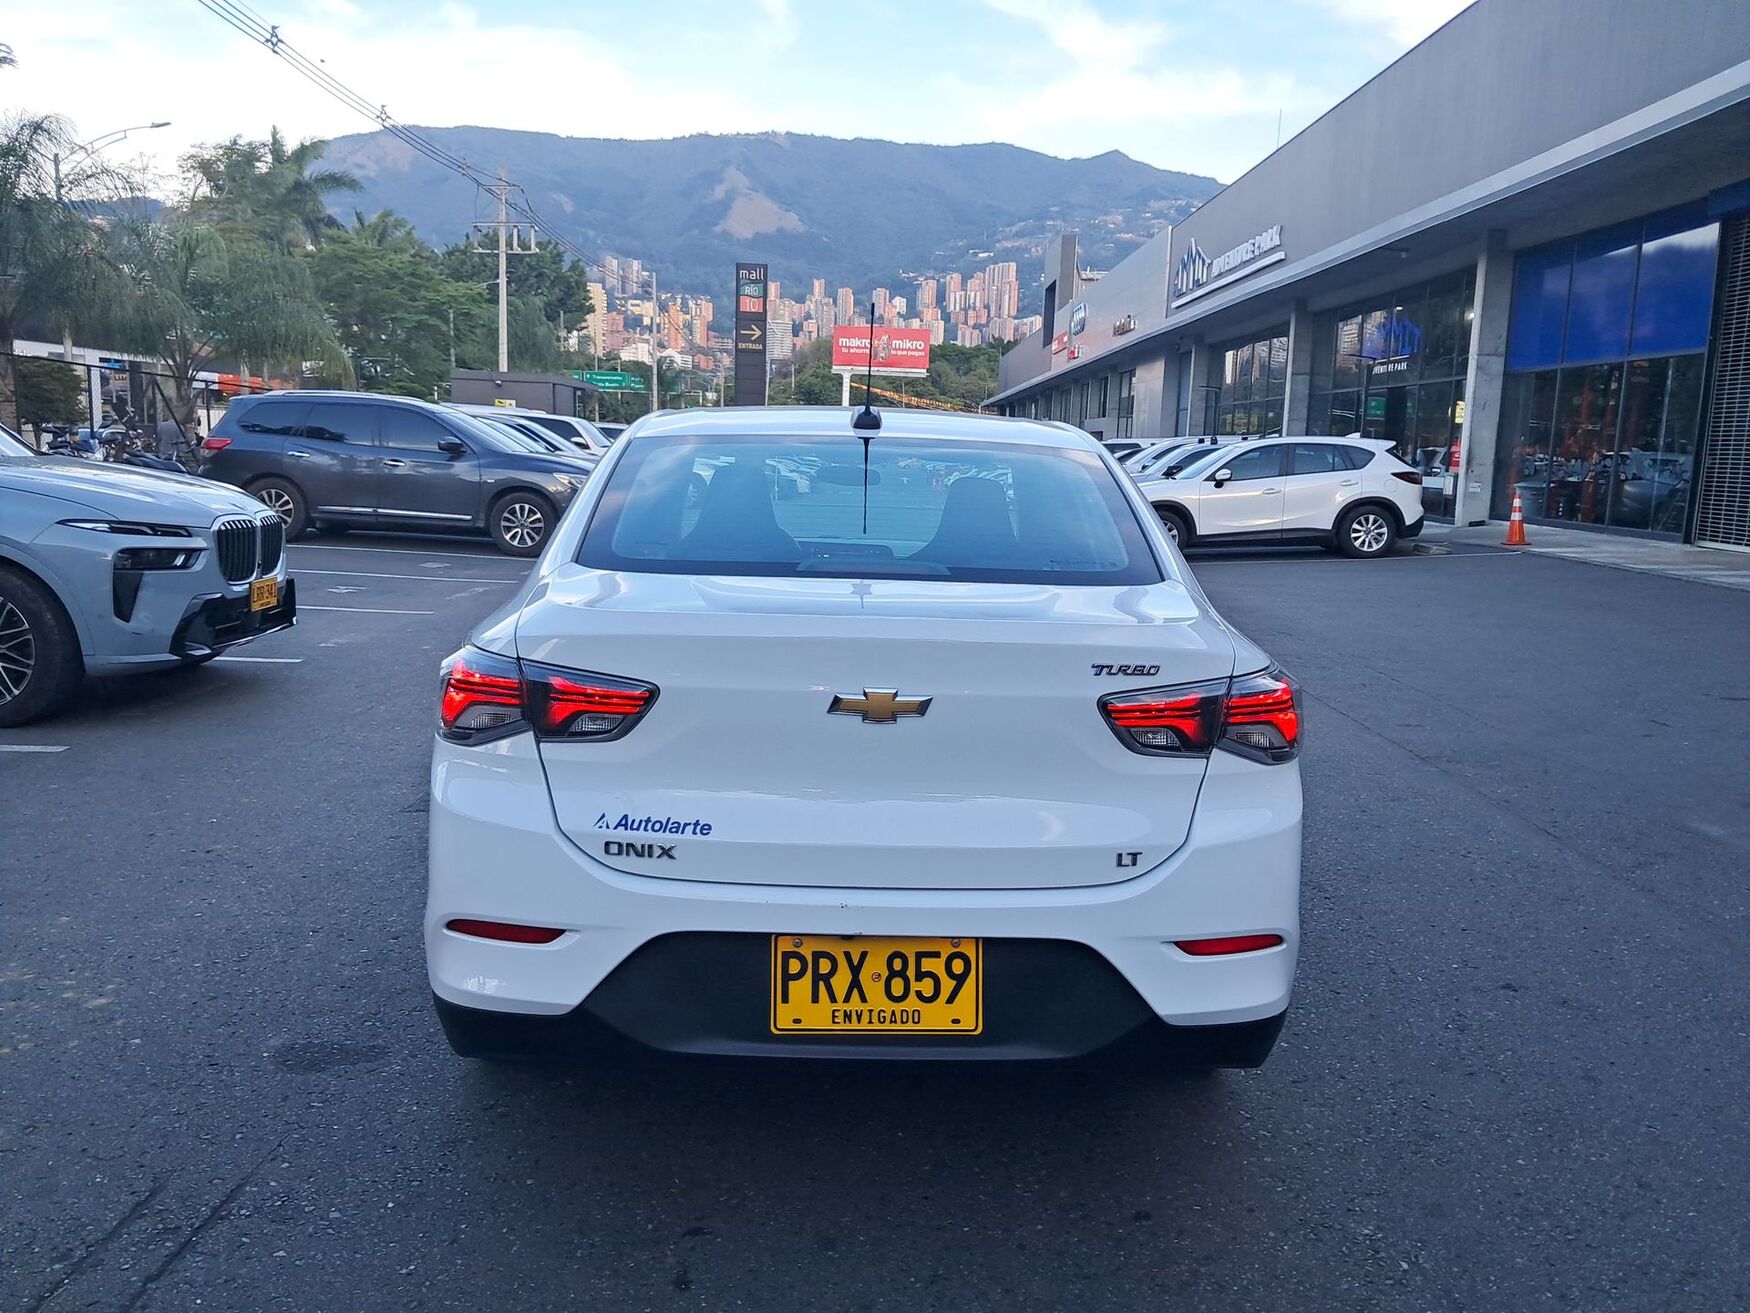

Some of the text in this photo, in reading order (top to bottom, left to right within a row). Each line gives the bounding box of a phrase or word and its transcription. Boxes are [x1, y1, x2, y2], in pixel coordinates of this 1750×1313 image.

[740, 267, 764, 280] mall
[738, 342, 763, 350] ENTRADA
[892, 339, 925, 350] mikro
[1394, 361, 1408, 371] PARK
[1091, 664, 1160, 677] TURBO
[613, 813, 713, 836] Autolarte
[604, 841, 677, 860] ONIX
[1116, 852, 1143, 867] LT
[780, 950, 973, 1005] PRX 859
[831, 1008, 922, 1025] ENVIGADO
